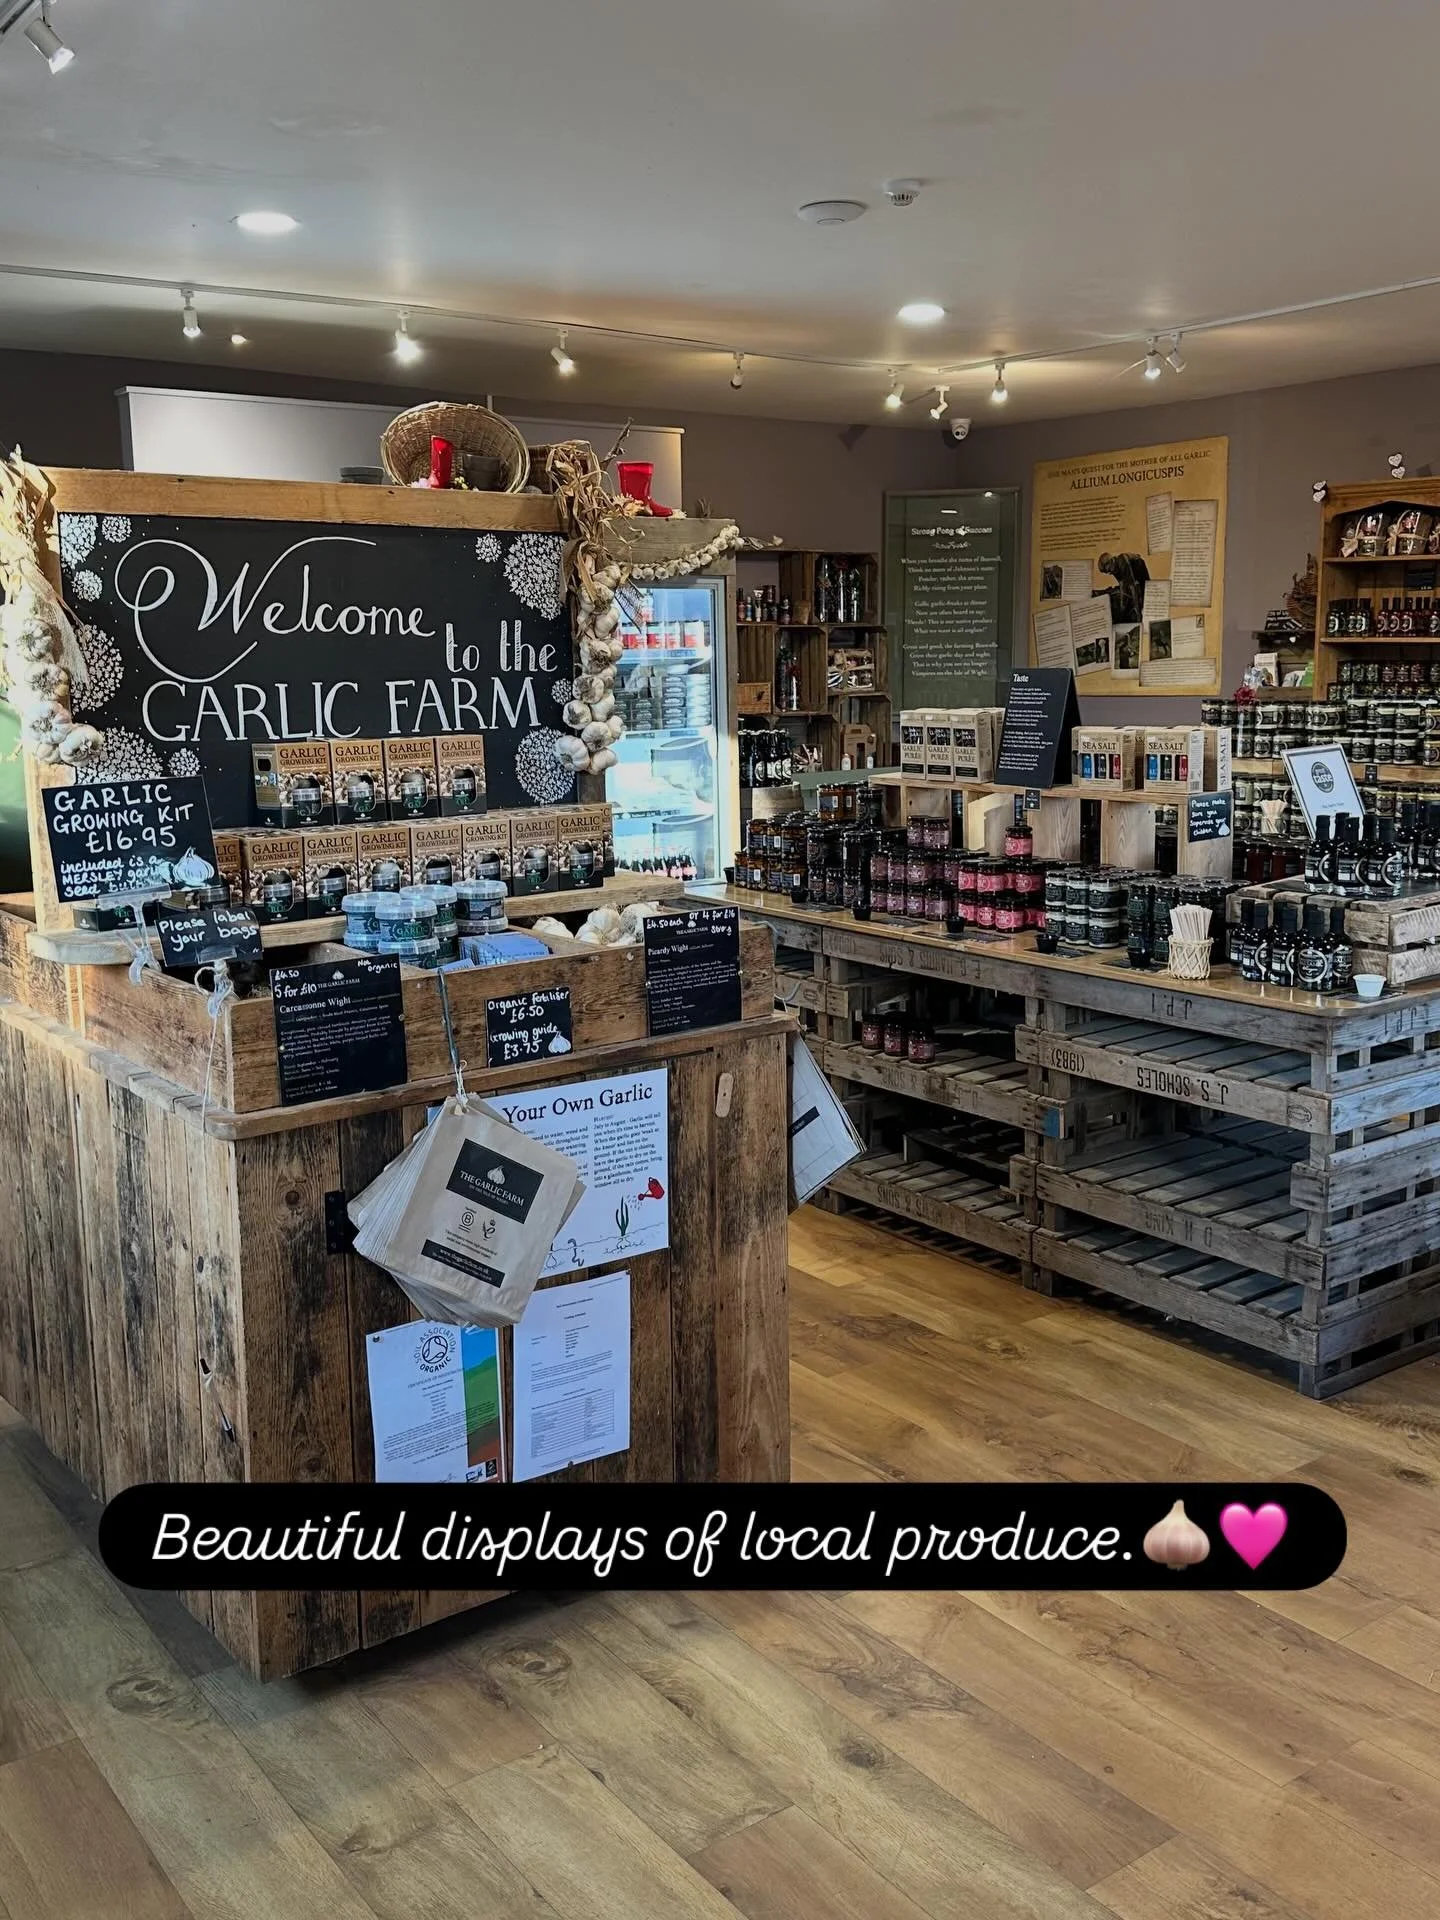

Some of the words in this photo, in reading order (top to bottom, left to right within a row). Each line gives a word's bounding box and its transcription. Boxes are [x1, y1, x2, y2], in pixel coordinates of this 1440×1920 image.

[1081, 465, 1100, 475] QUEST
[1101, 464, 1114, 472] FOR
[1116, 461, 1129, 469] THE
[1130, 457, 1158, 468] MOTHER
[1158, 455, 1168, 464] OF
[1168, 453, 1182, 462] ALL
[1183, 450, 1212, 461] GARLIC
[1070, 474, 1111, 490] ALLIUM
[1112, 465, 1185, 485] LONGICUSPIS
[114, 536, 436, 683] Welcome
[444, 622, 480, 673] to
[500, 619, 558, 673] the
[1013, 673, 1029, 683] Taste
[142, 679, 361, 743] GARLIC
[388, 676, 542, 735] FARM
[334, 744, 380, 757] GARLIC
[388, 742, 432, 754] GARLIC
[441, 739, 482, 751] GARLIC
[954, 747, 976, 755] GARLIC
[1082, 742, 1099, 750] SEA
[1098, 742, 1117, 750] SALT
[1148, 742, 1164, 750] SEA
[1164, 742, 1184, 751] SALT
[279, 747, 326, 759] GARLIC
[335, 755, 368, 764] GROWING
[369, 754, 381, 762] KIT
[389, 753, 420, 761] GROWING
[441, 750, 471, 758] GROWING
[471, 749, 482, 757] KIT
[279, 757, 314, 766] GROWING
[315, 757, 327, 765] KIT
[54, 784, 172, 812] GARLIC
[1191, 799, 1210, 808] Please
[1212, 799, 1226, 807] make
[53, 810, 144, 834] GROWING
[158, 803, 194, 823] KIT
[560, 816, 600, 828] GARLIC
[465, 823, 508, 836] GARLIC
[515, 821, 555, 833] GARLIC
[560, 826, 591, 834] GROWING
[361, 831, 406, 845] GARLIC
[416, 828, 459, 841] GARLIC
[465, 835, 497, 843] GROWING
[496, 833, 508, 841] KIT
[515, 831, 546, 840] GROWING
[252, 841, 299, 855] GARLIC
[307, 835, 353, 849] GARLIC
[361, 843, 395, 851] GROWING
[416, 839, 449, 848] GROWING
[449, 838, 460, 846] KIT
[251, 854, 288, 863] GROWING
[288, 851, 300, 859] KIT
[307, 847, 340, 857] GROWING
[341, 846, 353, 855] KIT
[60, 857, 124, 874] included
[129, 855, 144, 867] is
[148, 855, 164, 865] a
[62, 869, 123, 885] MERSLEY
[64, 884, 101, 898] seed
[159, 917, 207, 934] Please
[213, 910, 250, 923] label
[646, 918, 669, 930] £4.50
[669, 917, 684, 926] each
[688, 912, 699, 920] or
[702, 910, 710, 920] 4
[711, 910, 723, 921] for
[170, 931, 206, 952] your
[219, 925, 258, 939] bags
[647, 947, 671, 956] Picardy
[670, 944, 689, 953] Wight
[367, 962, 398, 974] organic
[274, 982, 282, 999] 5
[283, 984, 298, 998] for
[300, 982, 318, 996] £10
[279, 1001, 327, 1014] Carcassonne
[327, 996, 352, 1007] Wight
[487, 997, 528, 1015] Organic
[509, 1005, 544, 1024] £6.50
[532, 1022, 558, 1041] guide
[503, 1039, 543, 1061] £3.75
[1050, 1047, 1085, 1075] (1983)
[1136, 1066, 1191, 1097] SCHOLES
[502, 1104, 547, 1124] Your
[552, 1096, 594, 1116] Own
[599, 1082, 653, 1107] Garlic
[459, 1170, 475, 1184] THE
[474, 1176, 504, 1197] GARLIC
[502, 1190, 525, 1207] FARM
[420, 1327, 457, 1354] ASSOCIATION
[419, 1357, 452, 1374] ORGANIC
